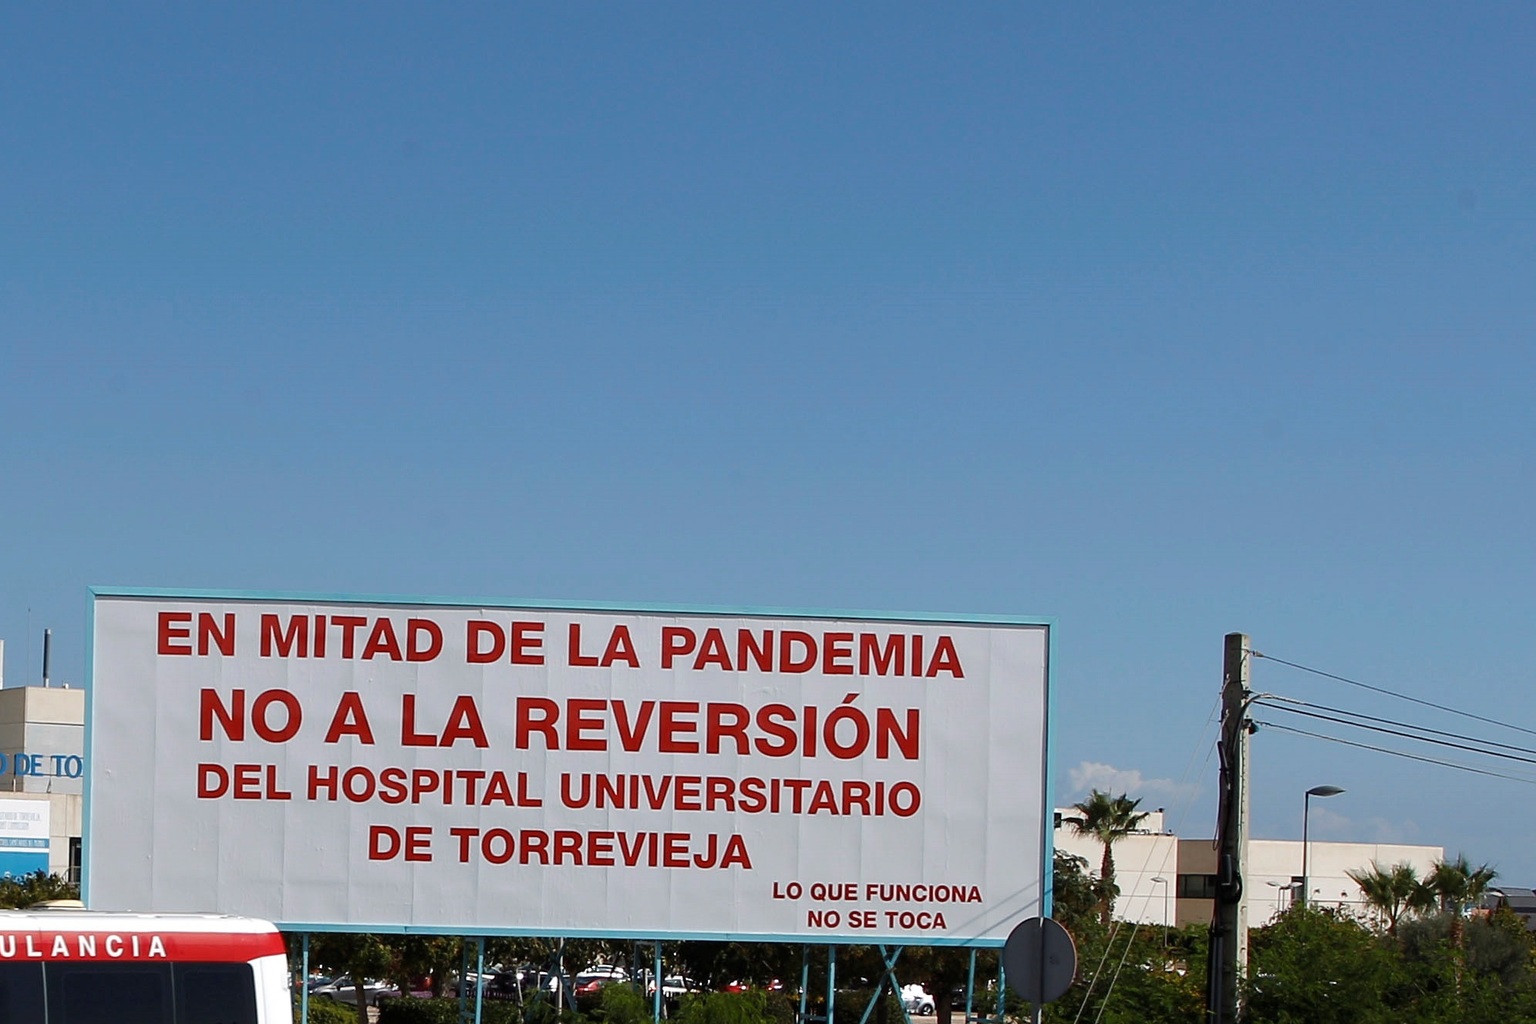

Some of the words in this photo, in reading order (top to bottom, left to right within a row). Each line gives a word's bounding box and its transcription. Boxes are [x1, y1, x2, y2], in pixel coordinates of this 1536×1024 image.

[157, 611, 236, 657] EN
[259, 613, 443, 663] MITAD
[466, 619, 545, 666] DE
[568, 623, 640, 669] LA
[661, 625, 964, 679] PANDEMIA
[199, 688, 303, 744] NO
[324, 691, 376, 746] A
[401, 693, 490, 749] LA
[515, 692, 922, 761] REVERSIÓN
[14, 753, 44, 777] DE
[50, 755, 83, 778] TO
[197, 763, 292, 801] DEL
[307, 765, 543, 808] HOSPITAL
[560, 772, 923, 818] UNIVERSITARIO
[368, 824, 434, 863] DE
[450, 827, 753, 870] TORREVIEJA
[772, 882, 803, 900] LO
[810, 882, 858, 901] QUE
[866, 883, 983, 903] FUNCIONA
[807, 910, 841, 928] NO
[848, 911, 877, 929] SE
[885, 911, 947, 930] TOCA
